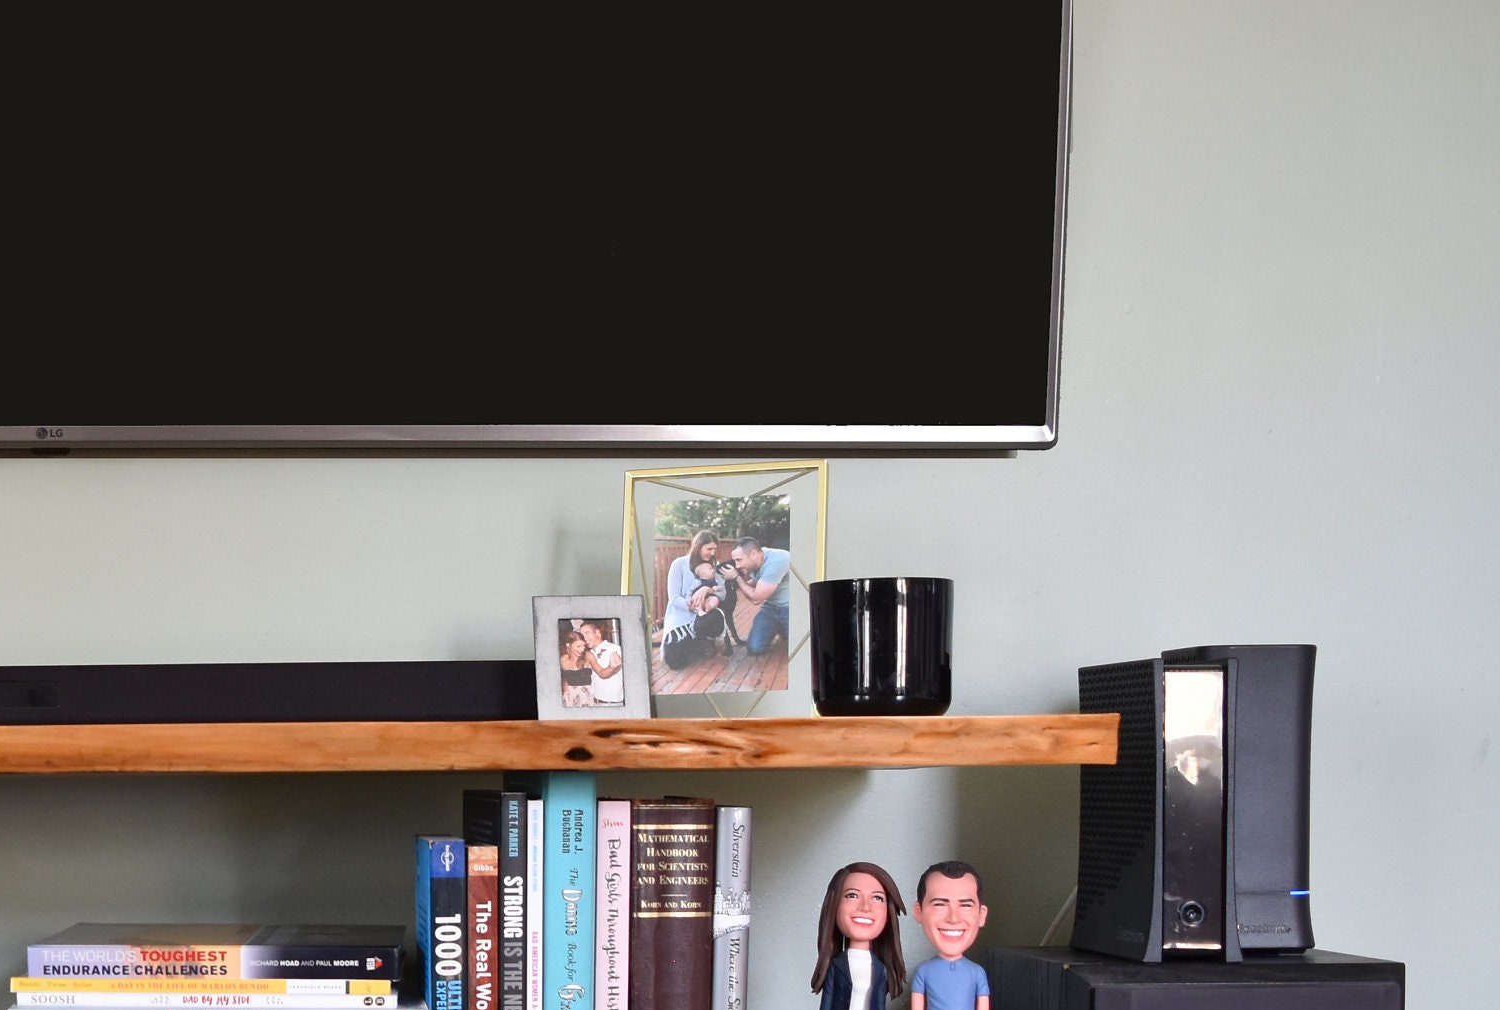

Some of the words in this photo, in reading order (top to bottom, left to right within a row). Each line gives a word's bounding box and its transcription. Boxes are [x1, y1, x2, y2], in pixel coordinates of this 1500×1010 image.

[50, 428, 64, 438] LG
[562, 810, 572, 854] Buchanan
[574, 810, 584, 842] Andrea
[509, 828, 518, 858] PARKER
[638, 834, 709, 843] MATHEMATICAL
[608, 838, 622, 870] Bad
[646, 848, 699, 857] HANDBOOK
[732, 823, 745, 878] Silverstein
[658, 862, 709, 871] SCIENTISTS
[570, 870, 578, 885] The
[638, 876, 655, 884] AND
[660, 876, 709, 885] ENGINEERS
[605, 872, 621, 904] Girls
[504, 876, 524, 938] STRONG
[664, 900, 678, 909] AND
[476, 900, 492, 934] The
[434, 913, 462, 976] 1000
[504, 942, 524, 957] IS
[602, 908, 620, 982] Throughout
[43, 950, 72, 962] THE
[73, 950, 137, 962] WORLD'S
[140, 950, 227, 962] TOUGHEST
[476, 939, 492, 978] Real
[568, 944, 576, 965] Book
[43, 965, 130, 976] ENDURANCE
[134, 965, 228, 976] CHALLENGES
[504, 961, 524, 991] THE
[568, 966, 576, 981] for
[31, 994, 75, 1004] SOOSH
[202, 996, 212, 1005] BY
[216, 996, 229, 1005] MY
[232, 996, 250, 1004] SIDE
